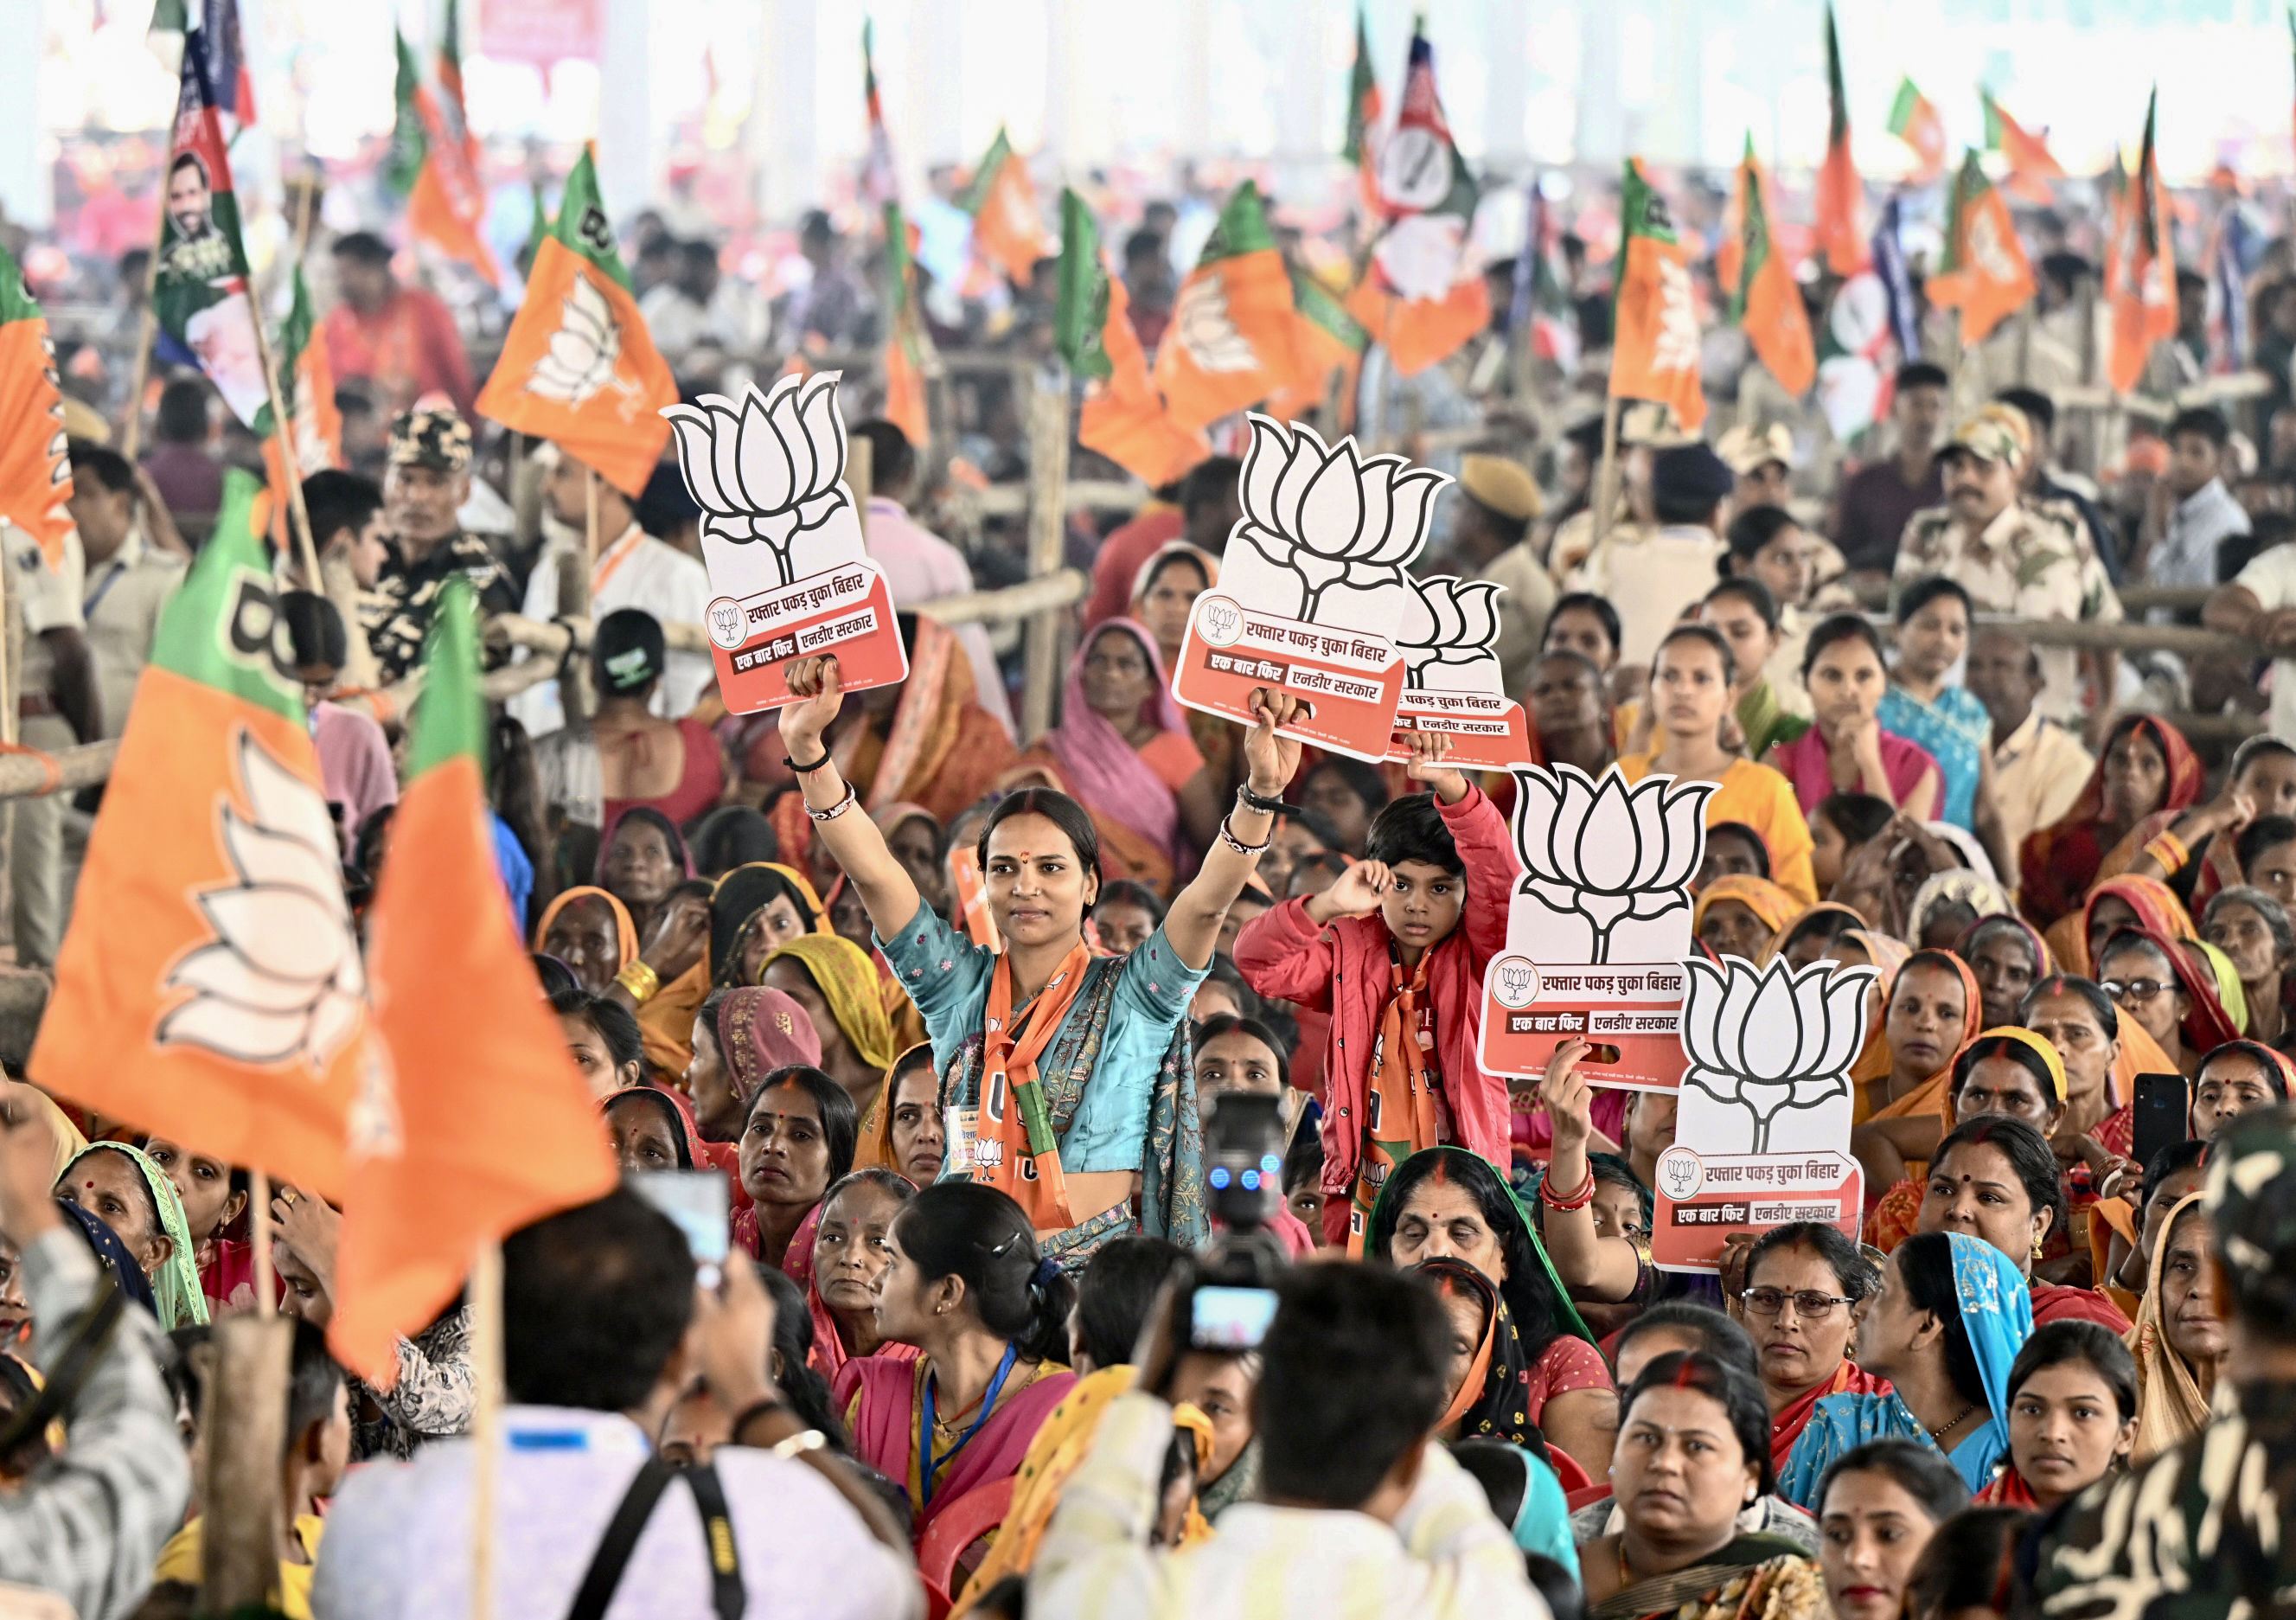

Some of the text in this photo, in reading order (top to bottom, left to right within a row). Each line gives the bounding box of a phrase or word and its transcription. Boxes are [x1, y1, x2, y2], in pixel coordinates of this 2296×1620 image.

[746, 573, 865, 624] रफ्तार पकड़ चुका बिहार
[735, 614, 873, 670] एक बार फिर एनडीए सरकार
[1246, 620, 1388, 663] रफ्तार पकड़ चुका बिहार
[1211, 654, 1231, 671] एक
[1233, 658, 1255, 676] बार
[1257, 663, 1283, 682] फिर
[1292, 671, 1333, 691] एनडीए
[1334, 679, 1379, 700] सरकार
[1404, 695, 1436, 708] पकड़
[1436, 696, 1463, 709] चुका
[1465, 695, 1502, 709] बिहार
[1422, 720, 1460, 731] एनडीए
[1461, 723, 1505, 733] सरकार
[1541, 971, 1683, 996] रफ्तार पकड़ चुका बिहार
[1512, 1013, 1679, 1031] एक बार फिर एनडीए सरकार
[1704, 1160, 1840, 1185] रफ्तार पकड़ चुका बिहार
[1678, 1203, 1837, 1223] एक बार फिर एनडीए सरकार
